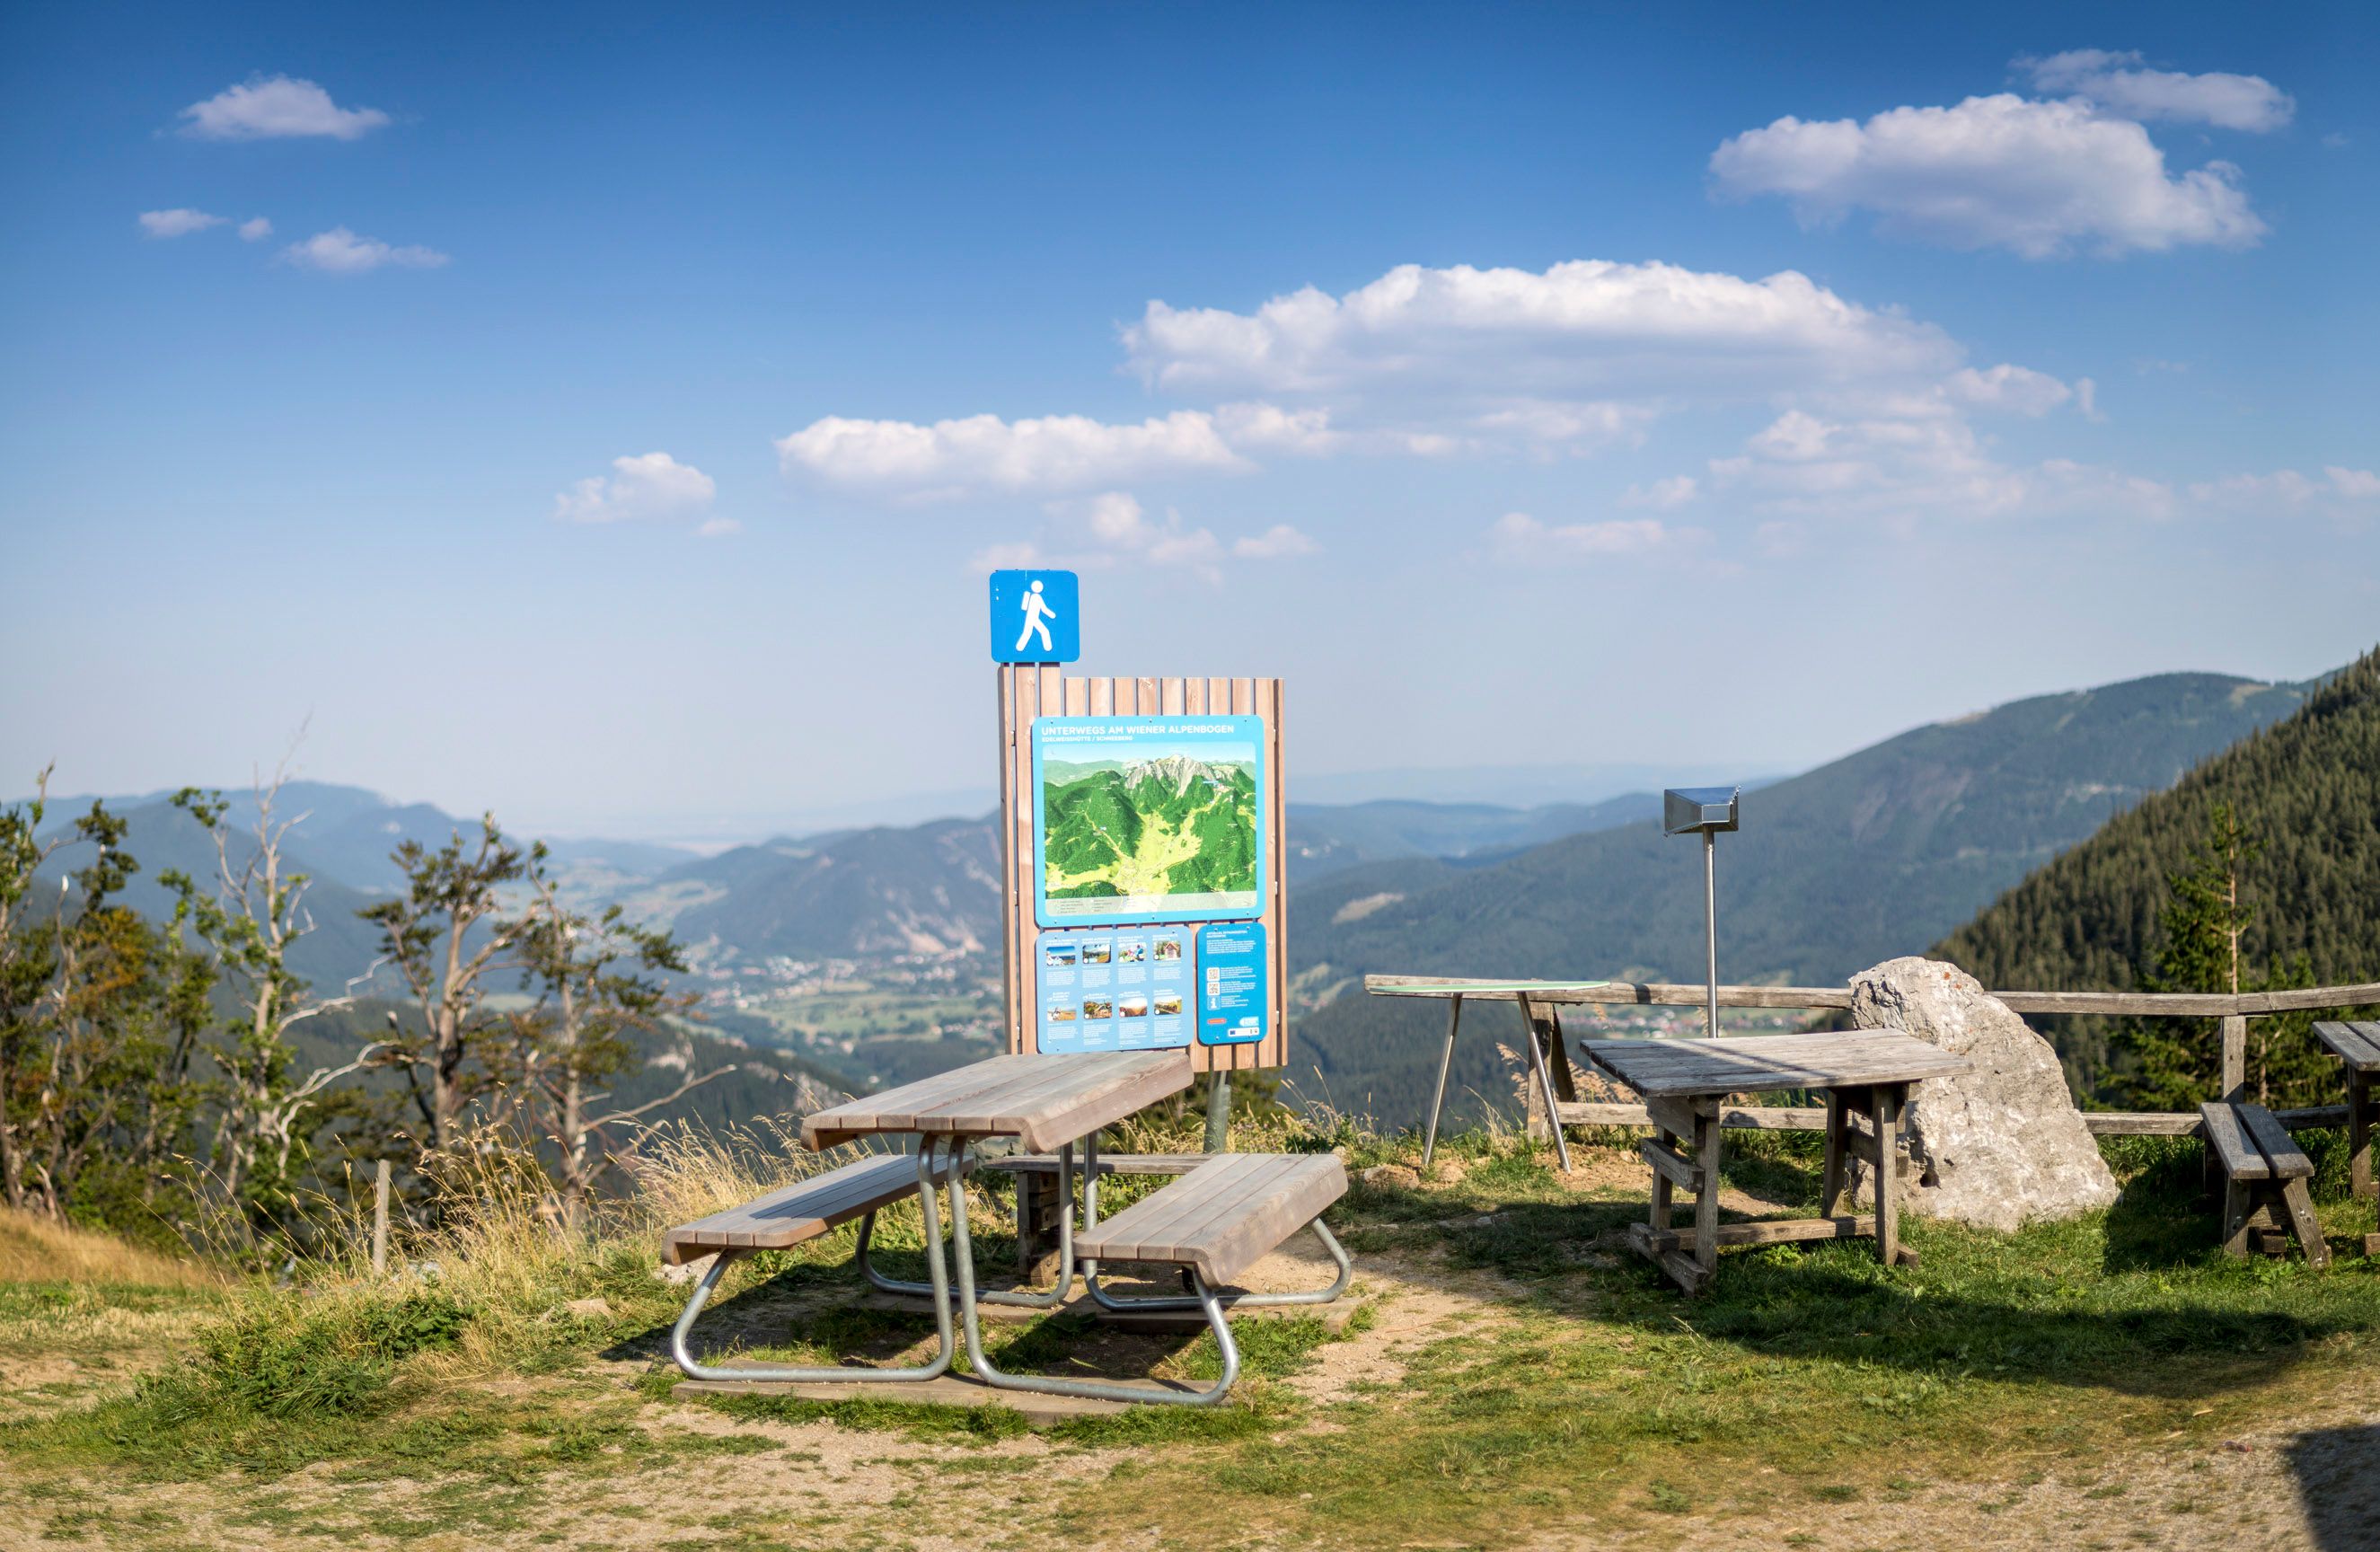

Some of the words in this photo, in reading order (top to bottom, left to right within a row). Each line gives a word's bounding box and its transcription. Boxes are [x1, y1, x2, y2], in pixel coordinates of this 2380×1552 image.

[1042, 727, 1106, 736] UNTERWEGS
[1108, 726, 1124, 735] AM
[1126, 725, 1166, 734] WIENER
[1168, 725, 1234, 734] ALPENBOGEN
